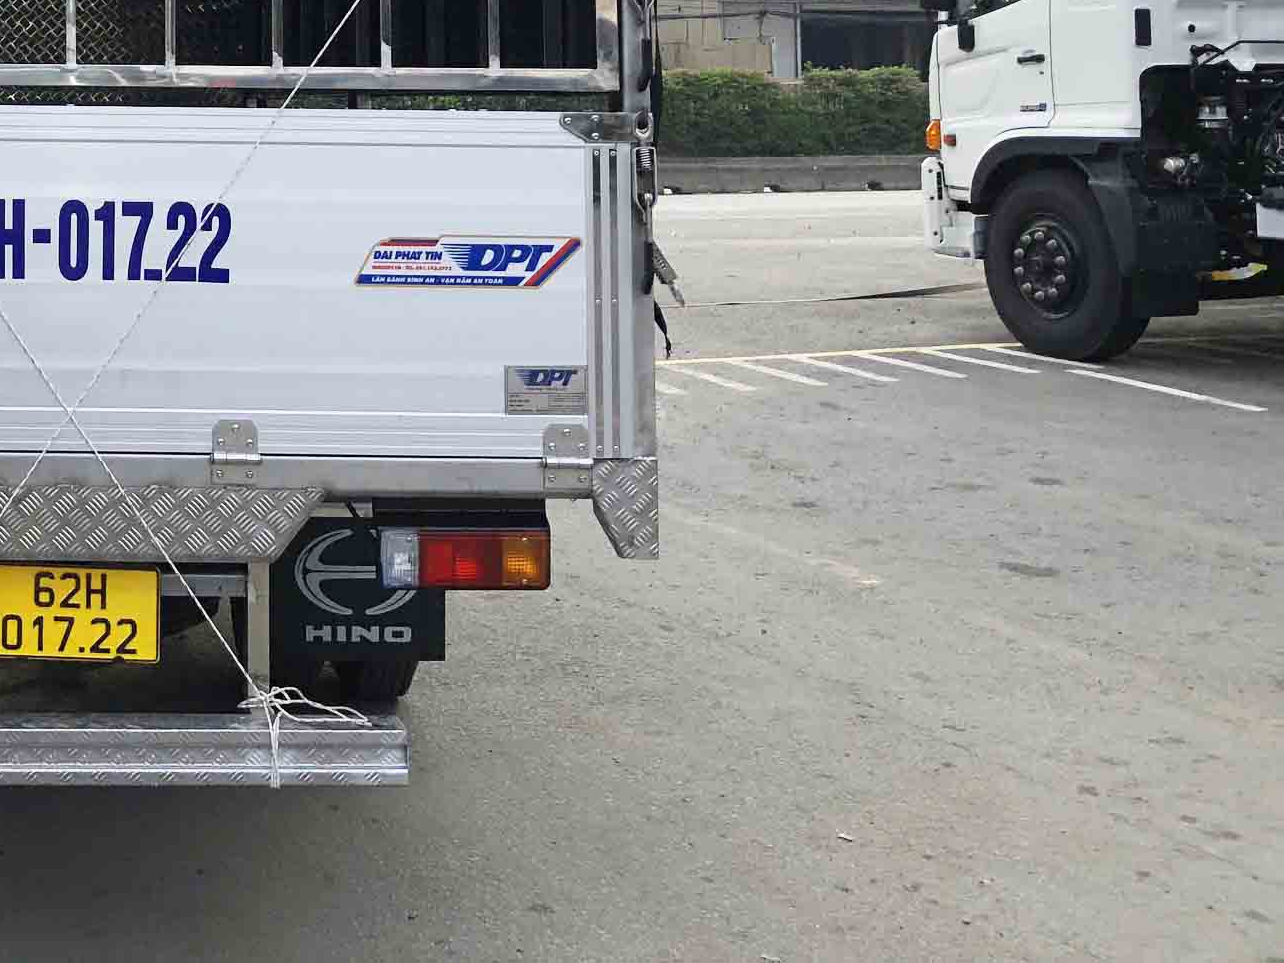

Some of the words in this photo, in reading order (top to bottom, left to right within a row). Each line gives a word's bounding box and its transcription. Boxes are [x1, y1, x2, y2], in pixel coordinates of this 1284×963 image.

[466, 243, 555, 272] DPT
[33, 571, 108, 610] 62H
[1, 613, 139, 655] 017.22
[305, 624, 413, 643] HINO
